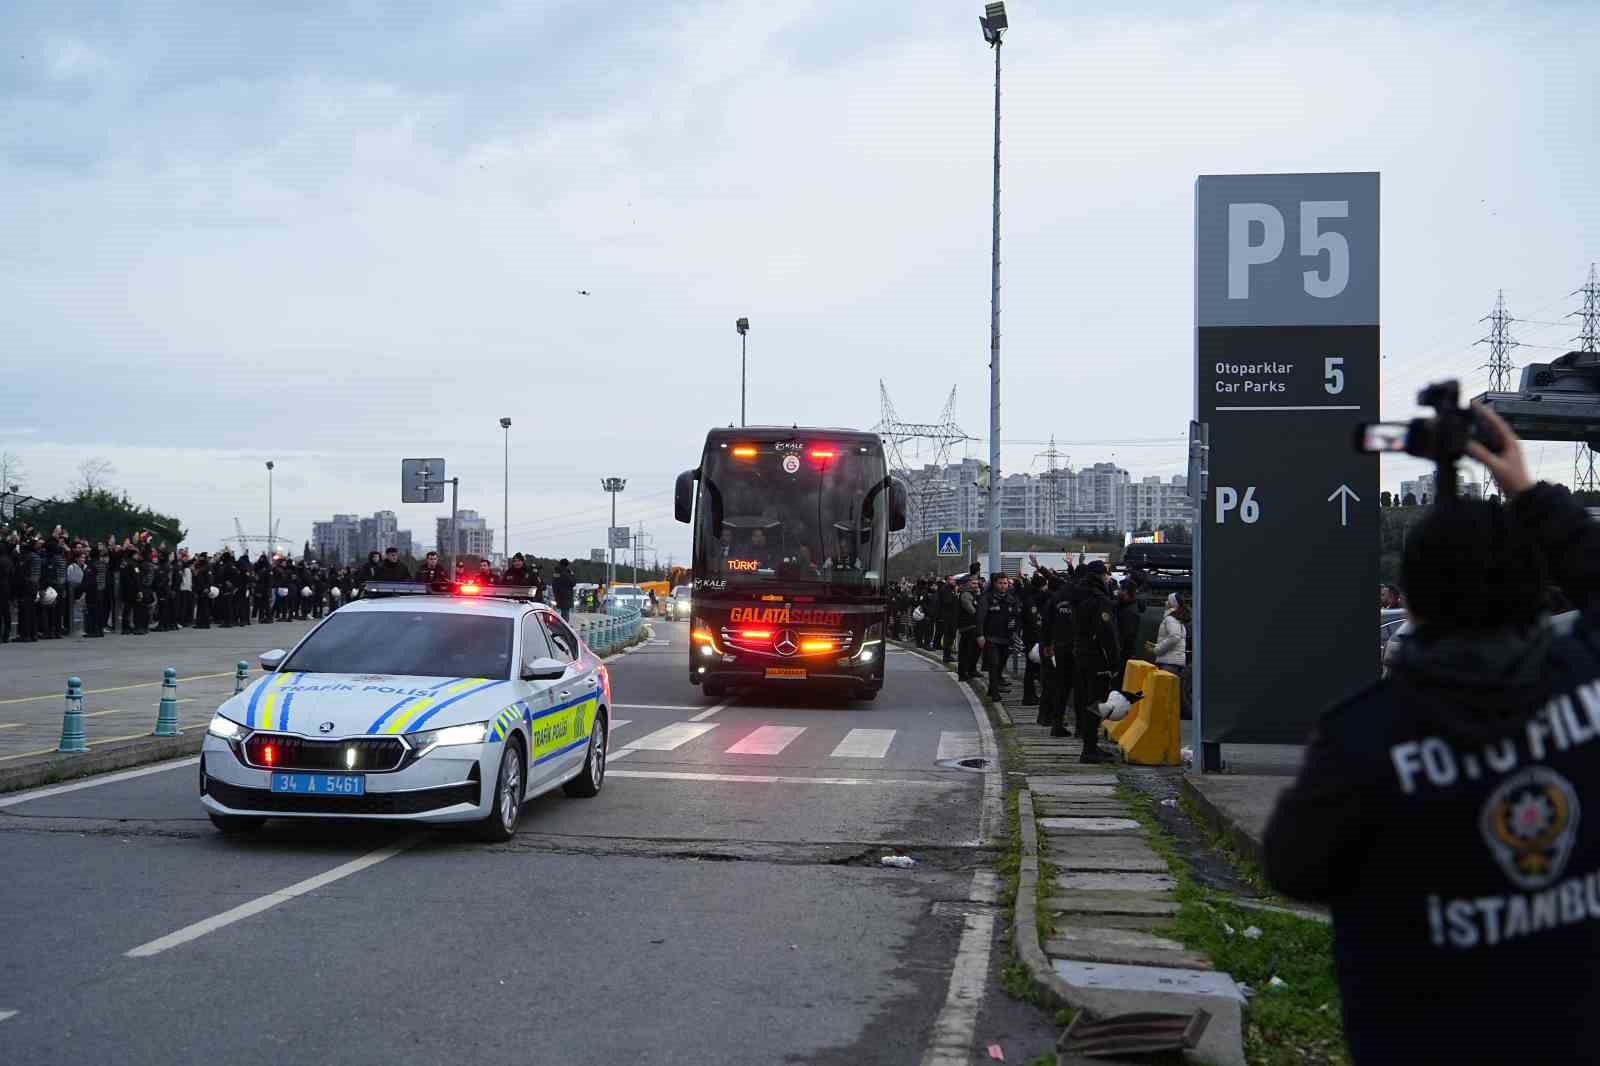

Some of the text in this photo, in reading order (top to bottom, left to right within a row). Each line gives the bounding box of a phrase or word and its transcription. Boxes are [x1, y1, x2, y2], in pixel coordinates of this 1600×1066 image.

[1228, 200, 1350, 299] P5
[1216, 357, 1345, 394] Otoparklar 5
[1216, 380, 1286, 392] Car Parks
[1216, 486, 1260, 523] P6
[280, 776, 359, 792] 34 A 5461
